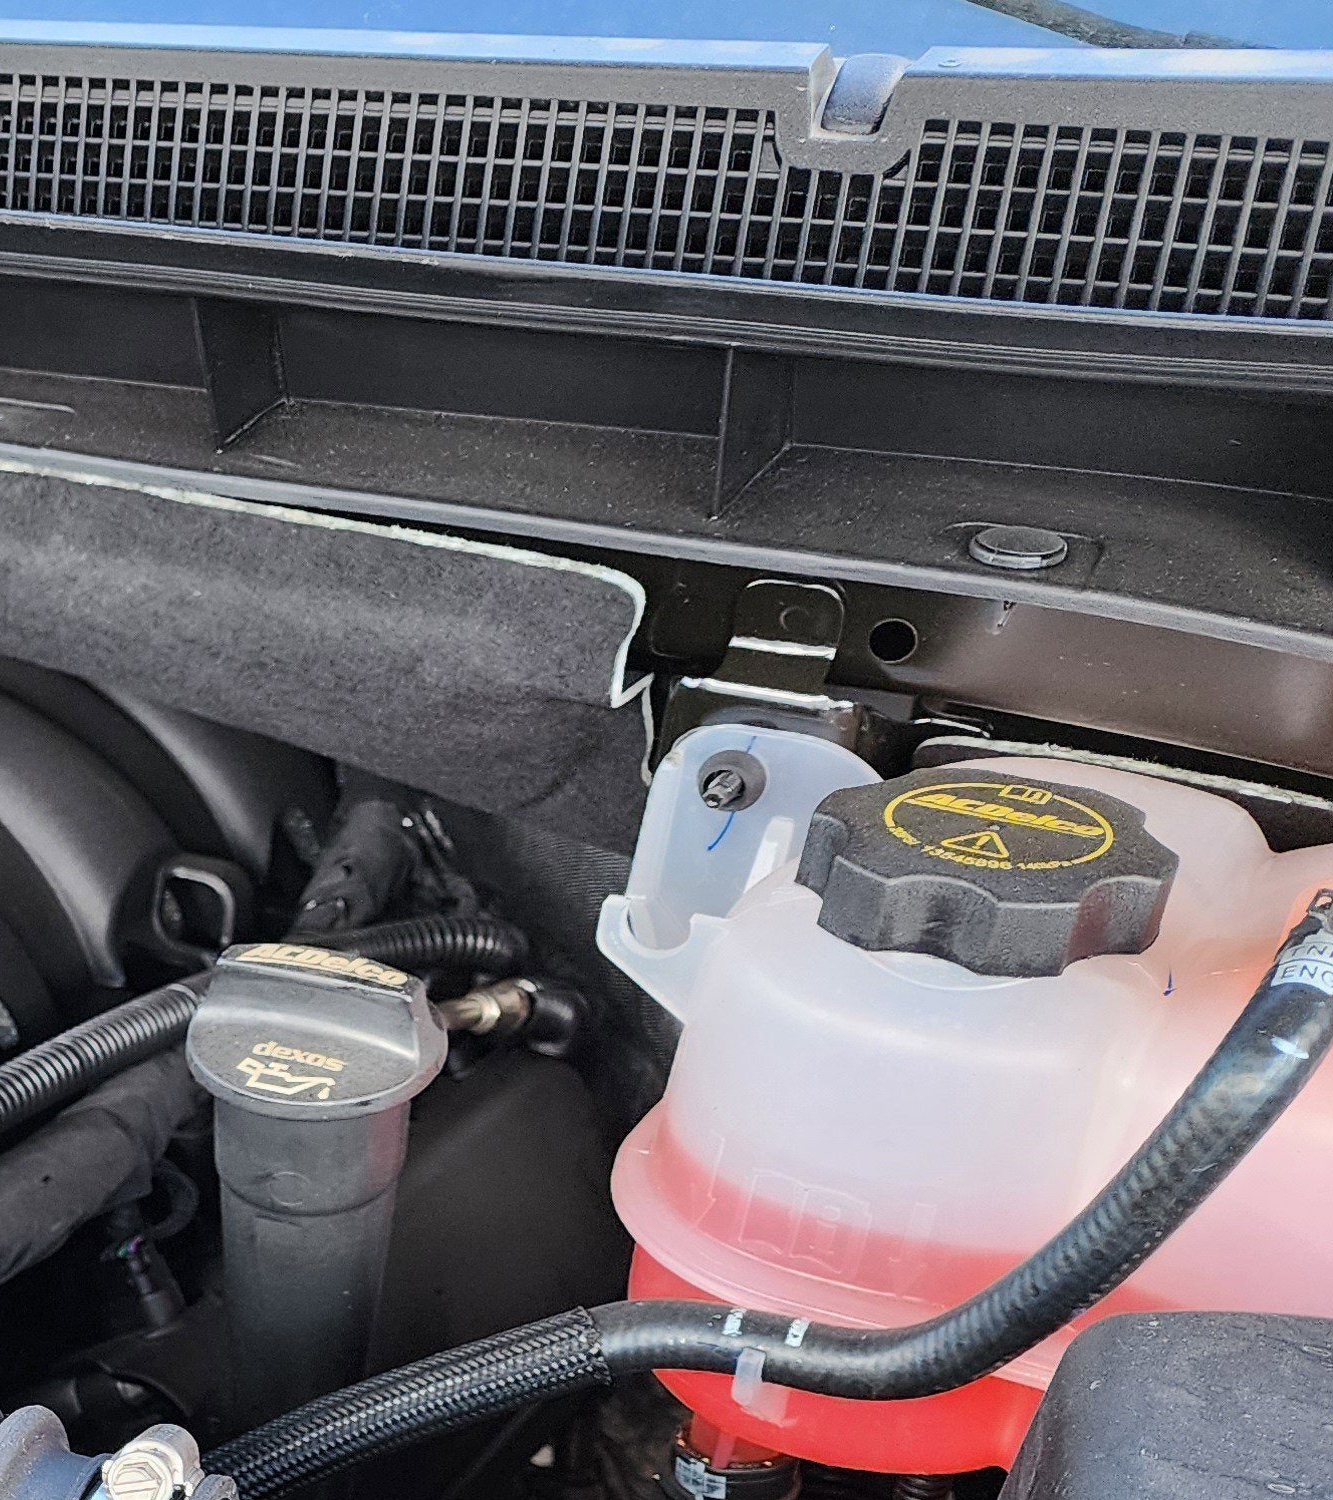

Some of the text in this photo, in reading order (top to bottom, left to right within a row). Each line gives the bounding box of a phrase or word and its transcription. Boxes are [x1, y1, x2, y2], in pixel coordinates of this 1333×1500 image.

[909, 793, 1107, 838] ACDelco
[237, 943, 408, 986] ACDelco
[252, 1040, 347, 1073] dexos
